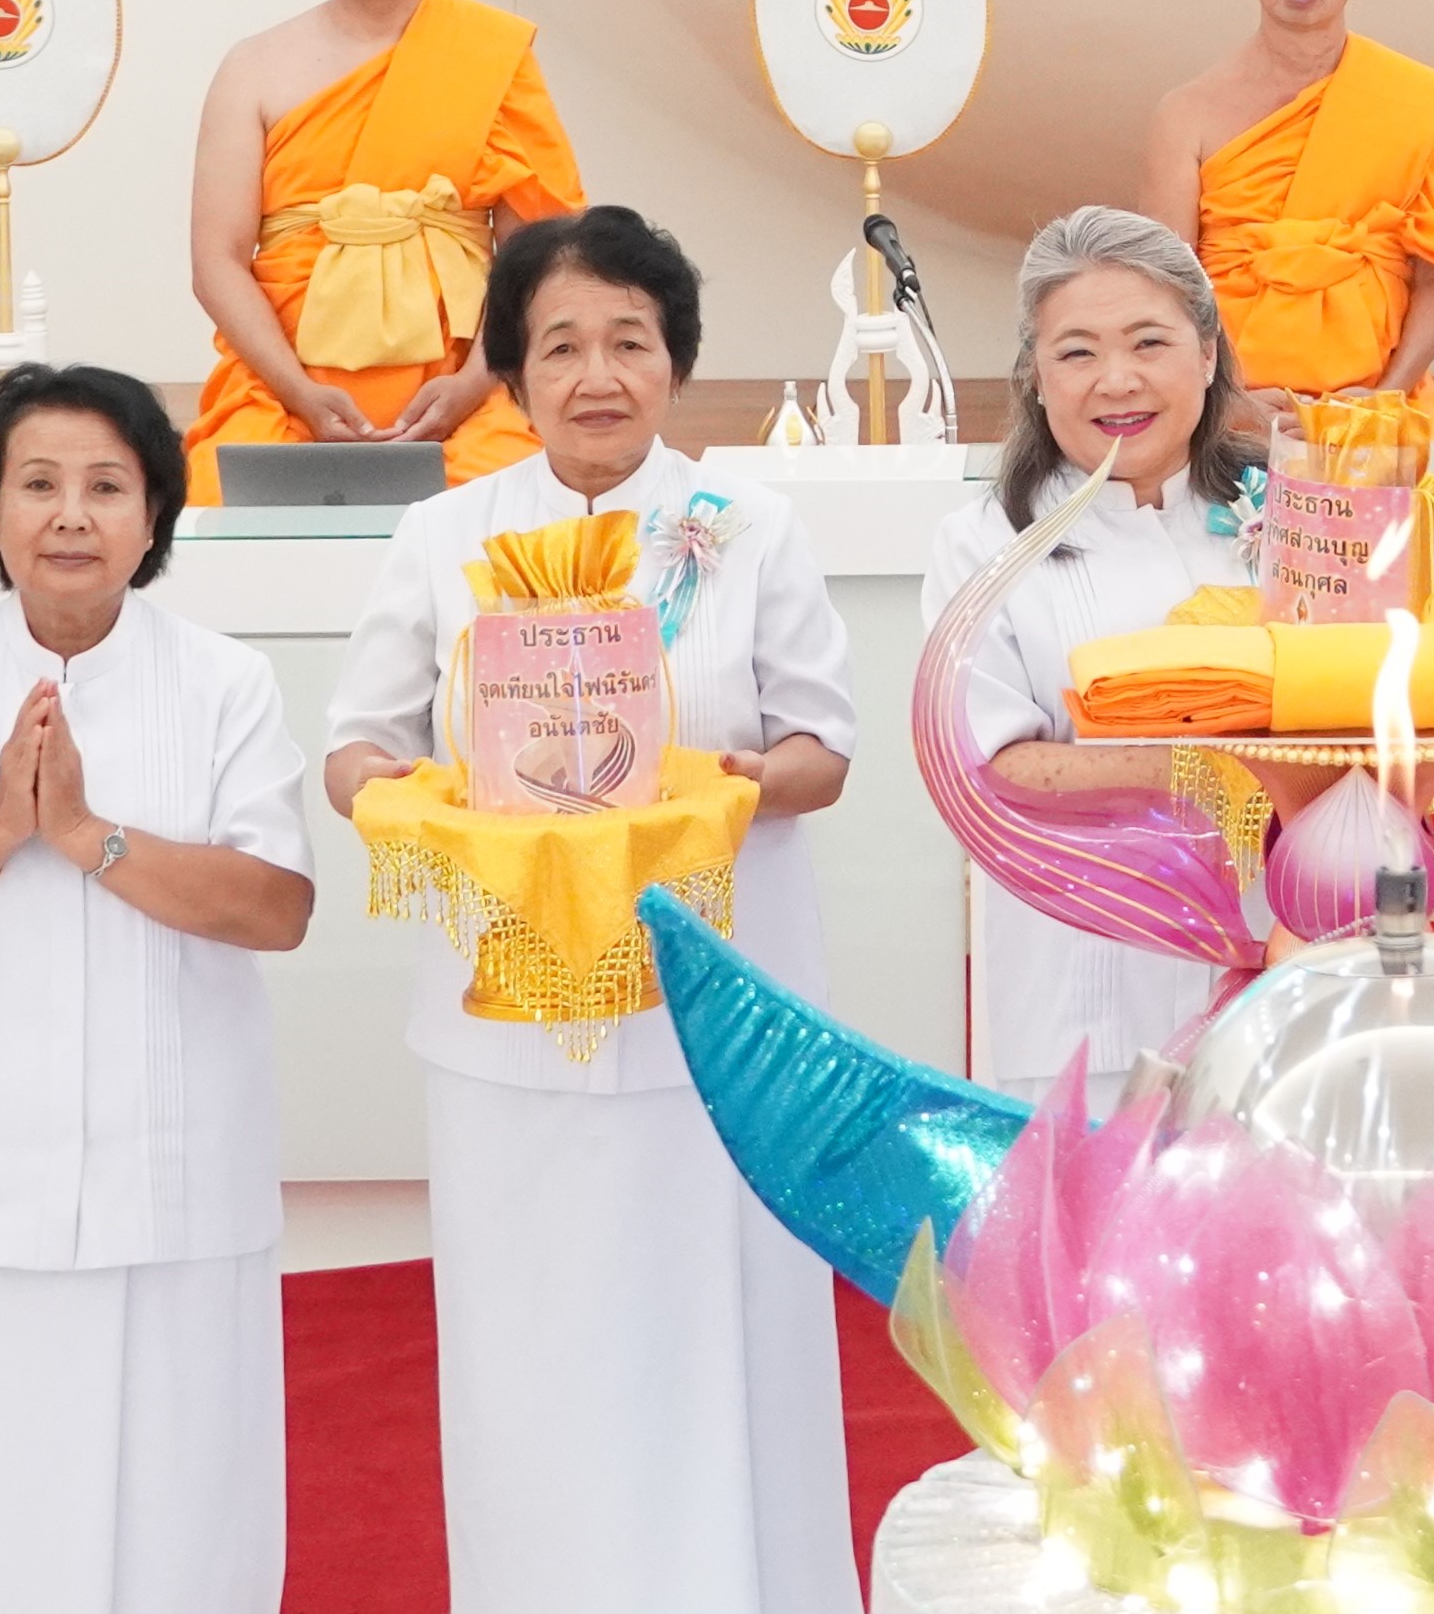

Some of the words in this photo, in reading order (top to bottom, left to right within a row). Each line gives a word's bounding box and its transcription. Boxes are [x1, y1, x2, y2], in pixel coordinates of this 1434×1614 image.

[1273, 482, 1353, 518] ประธาน
[1271, 557, 1348, 599] ส่วนกุศล
[520, 621, 622, 648] ประธาน
[529, 711, 619, 739] อนันตชัย
